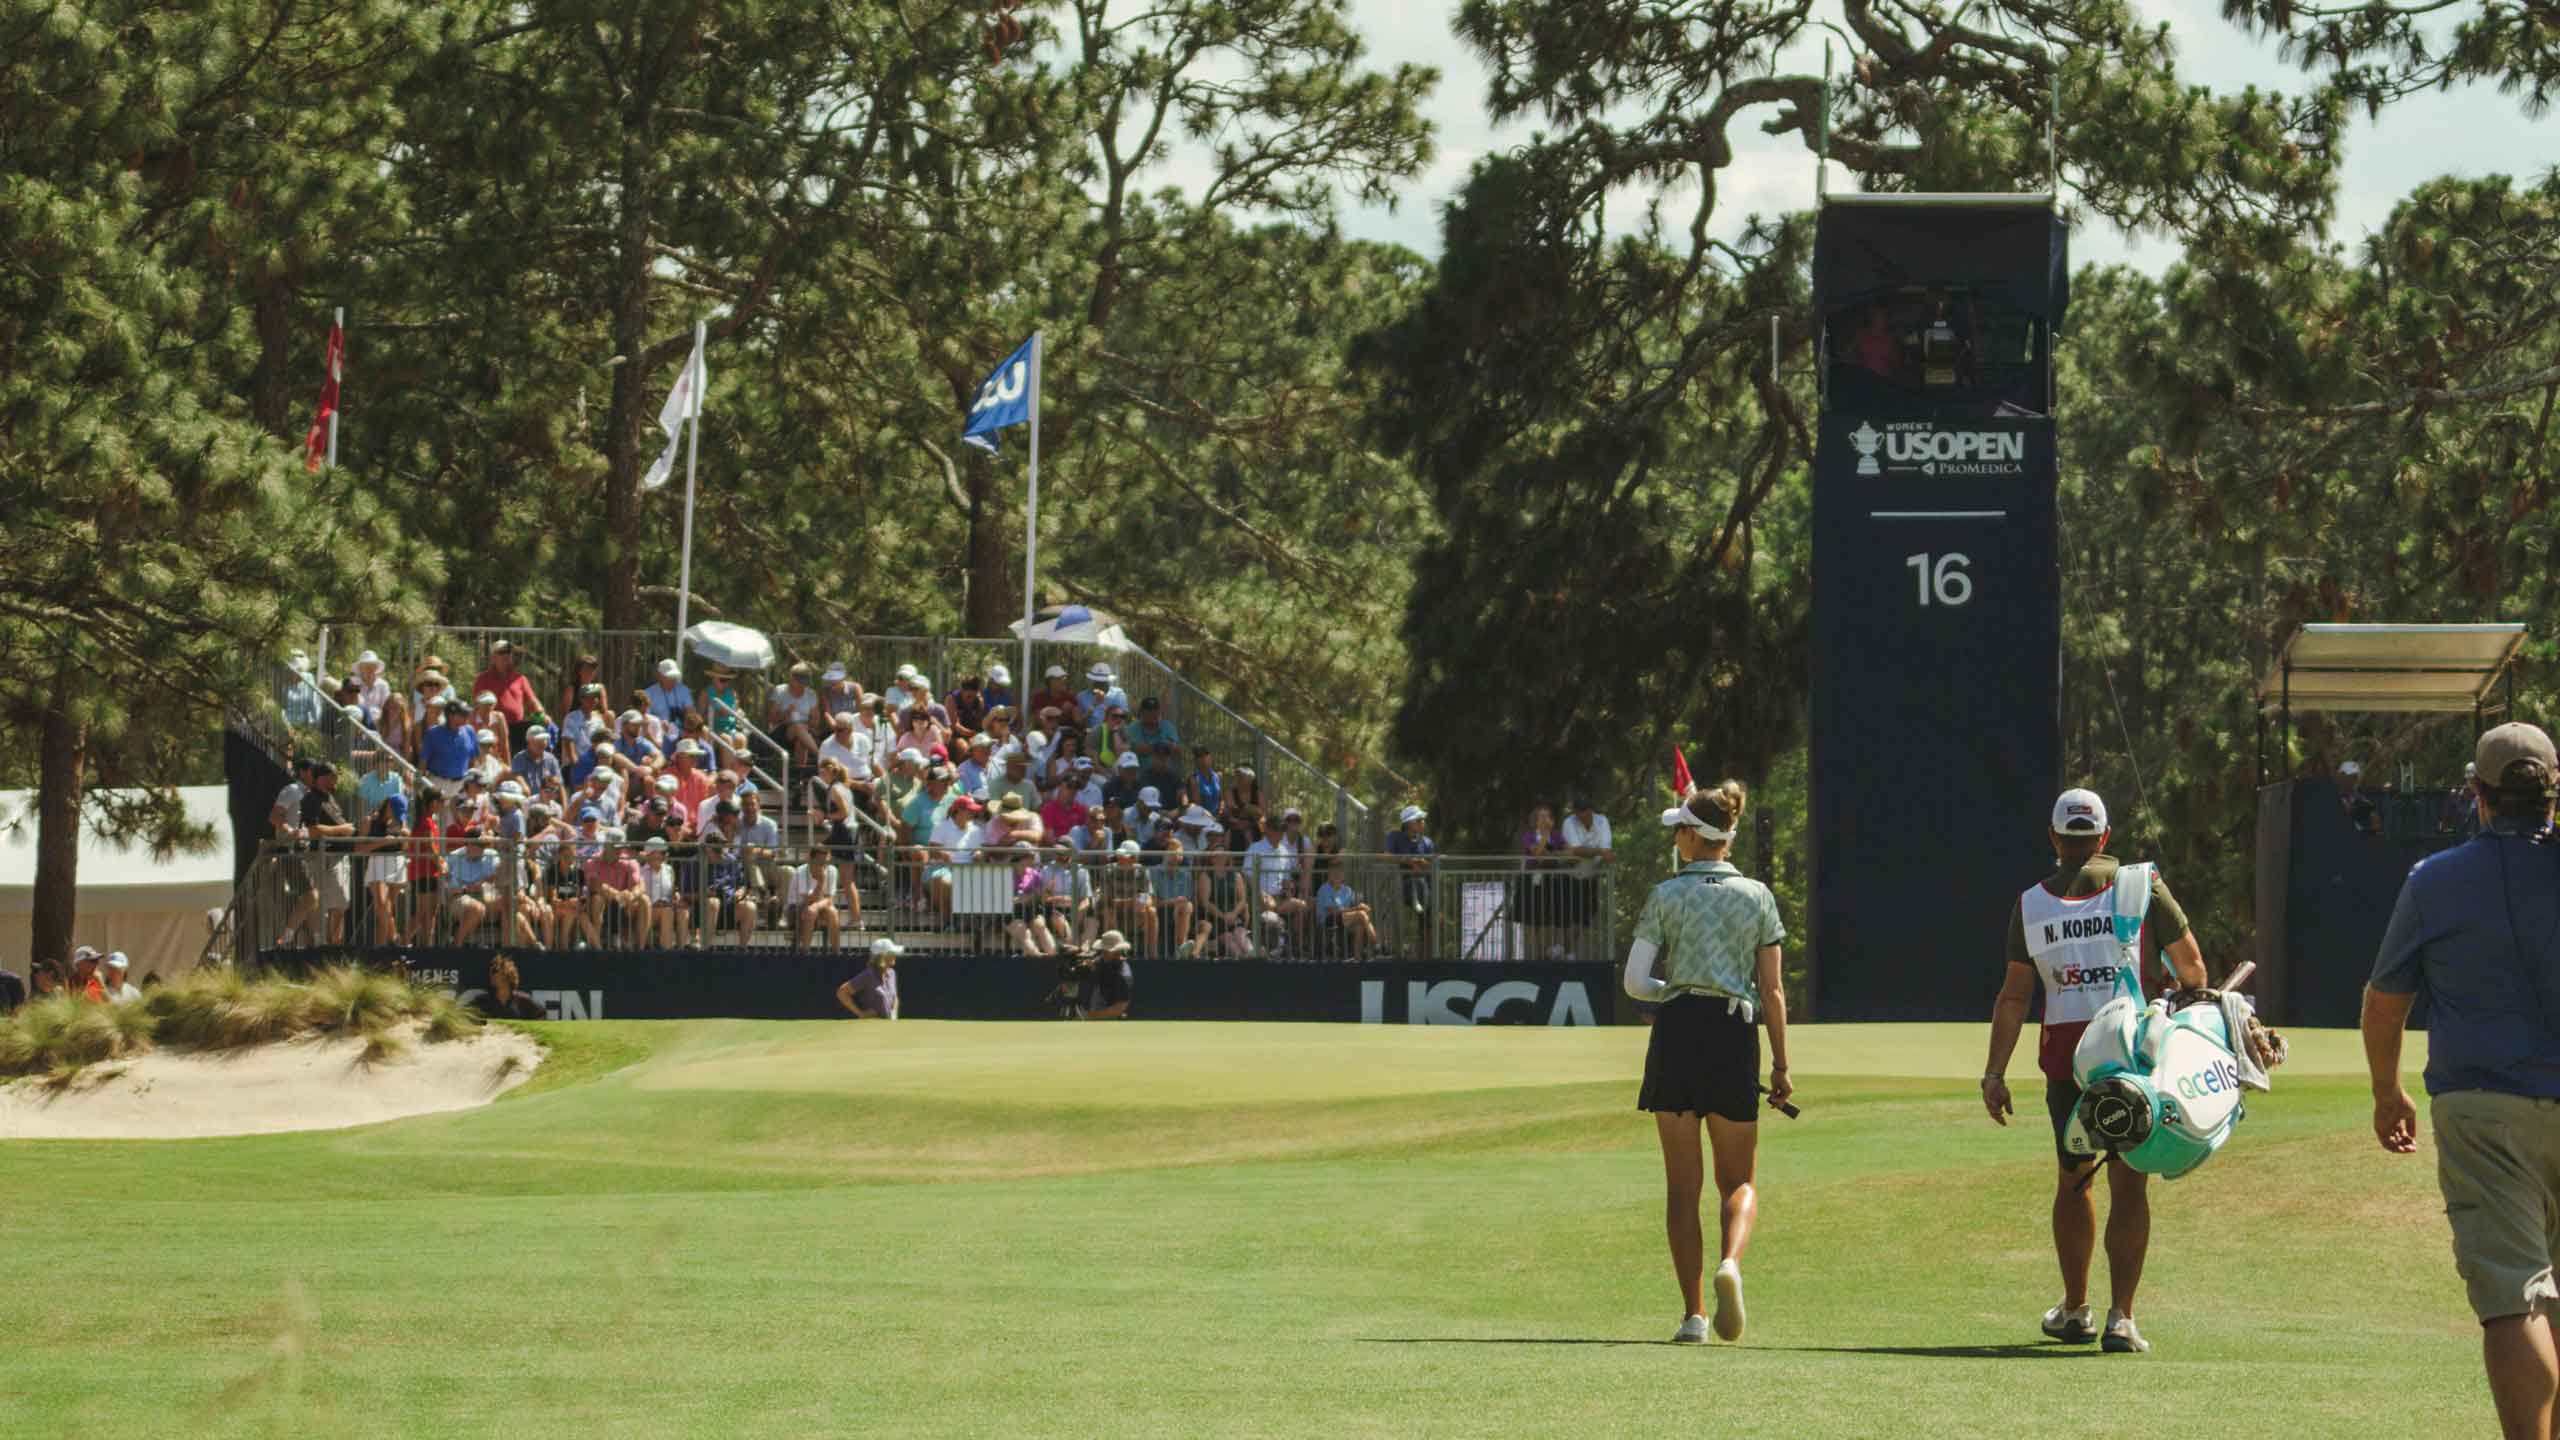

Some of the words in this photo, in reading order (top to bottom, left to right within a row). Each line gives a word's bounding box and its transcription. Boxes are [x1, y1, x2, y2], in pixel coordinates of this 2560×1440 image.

[1886, 423, 1933, 431] WOMEN'S
[1906, 552, 1972, 605] 16
[2044, 923, 2058, 944] N.
[2062, 916, 2114, 939] KORDA
[410, 969, 459, 985] MEN'S
